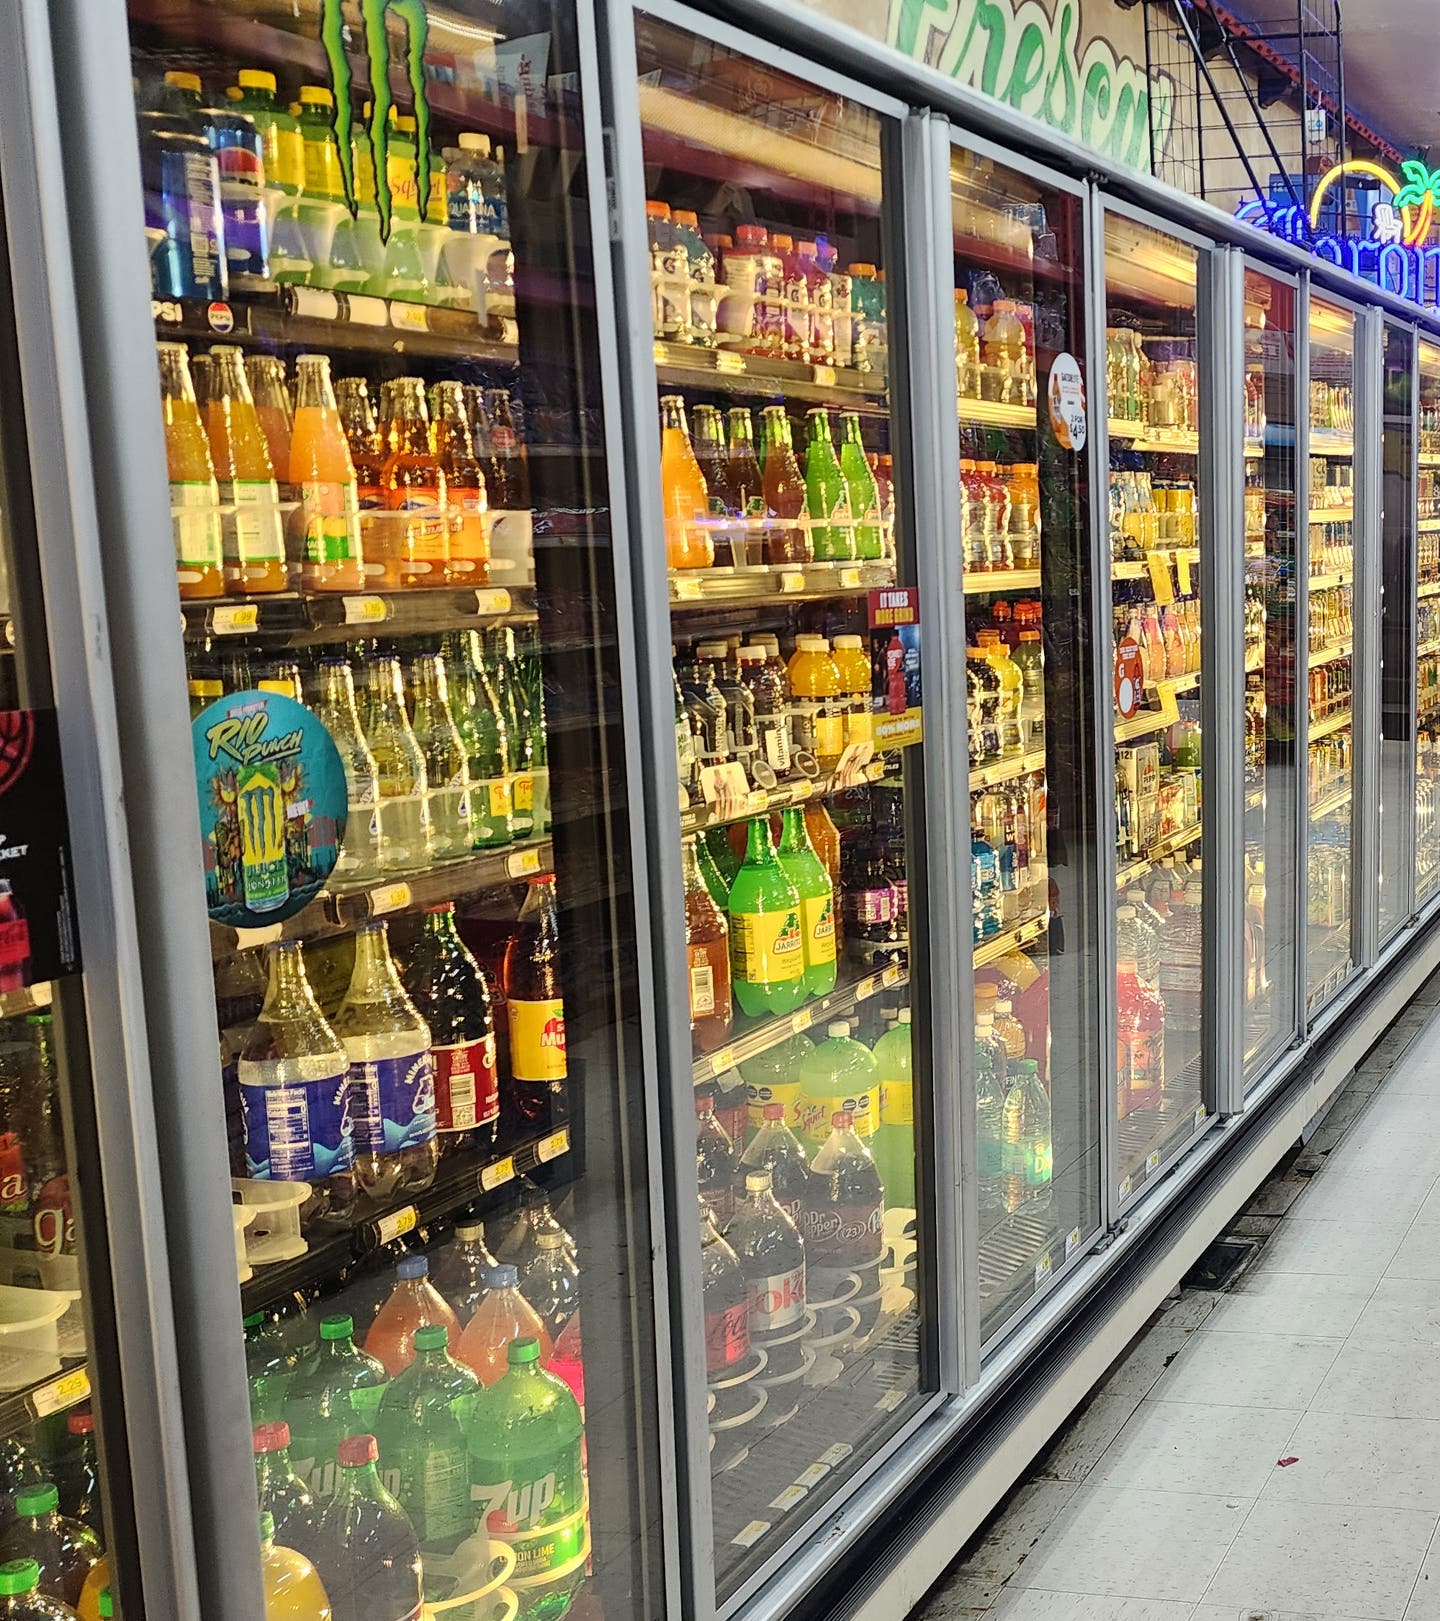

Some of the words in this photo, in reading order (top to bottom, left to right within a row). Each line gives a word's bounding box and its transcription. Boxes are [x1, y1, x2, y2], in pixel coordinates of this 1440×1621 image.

[206, 711, 268, 759] RIO
[241, 729, 303, 764] PUNCH
[58, 1380, 82, 1398] 2.29
[533, 1542, 555, 1560] LIME
